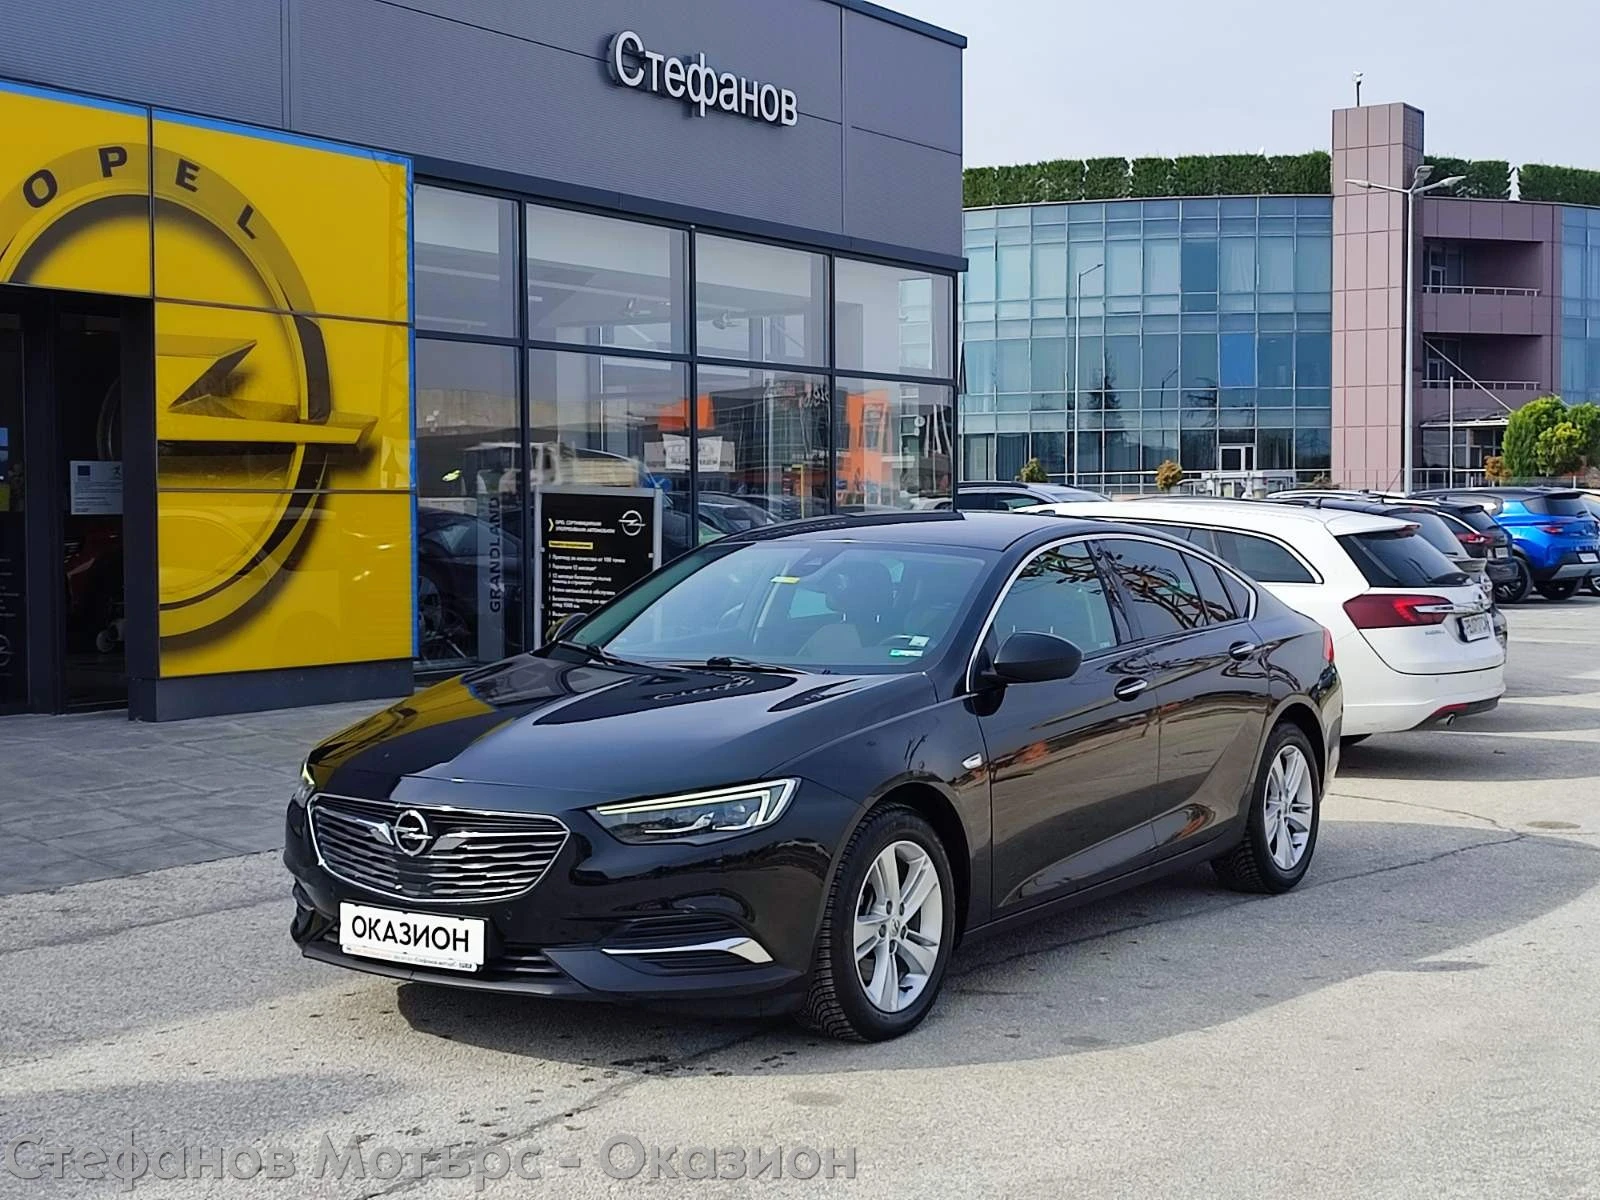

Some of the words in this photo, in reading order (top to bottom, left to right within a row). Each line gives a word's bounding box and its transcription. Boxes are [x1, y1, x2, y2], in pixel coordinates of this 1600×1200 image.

[613, 30, 798, 126] Стефанов
[22, 144, 260, 240] OPEL
[489, 497, 501, 613] GRANDLAND
[352, 915, 469, 953] ОКАЗИОН
